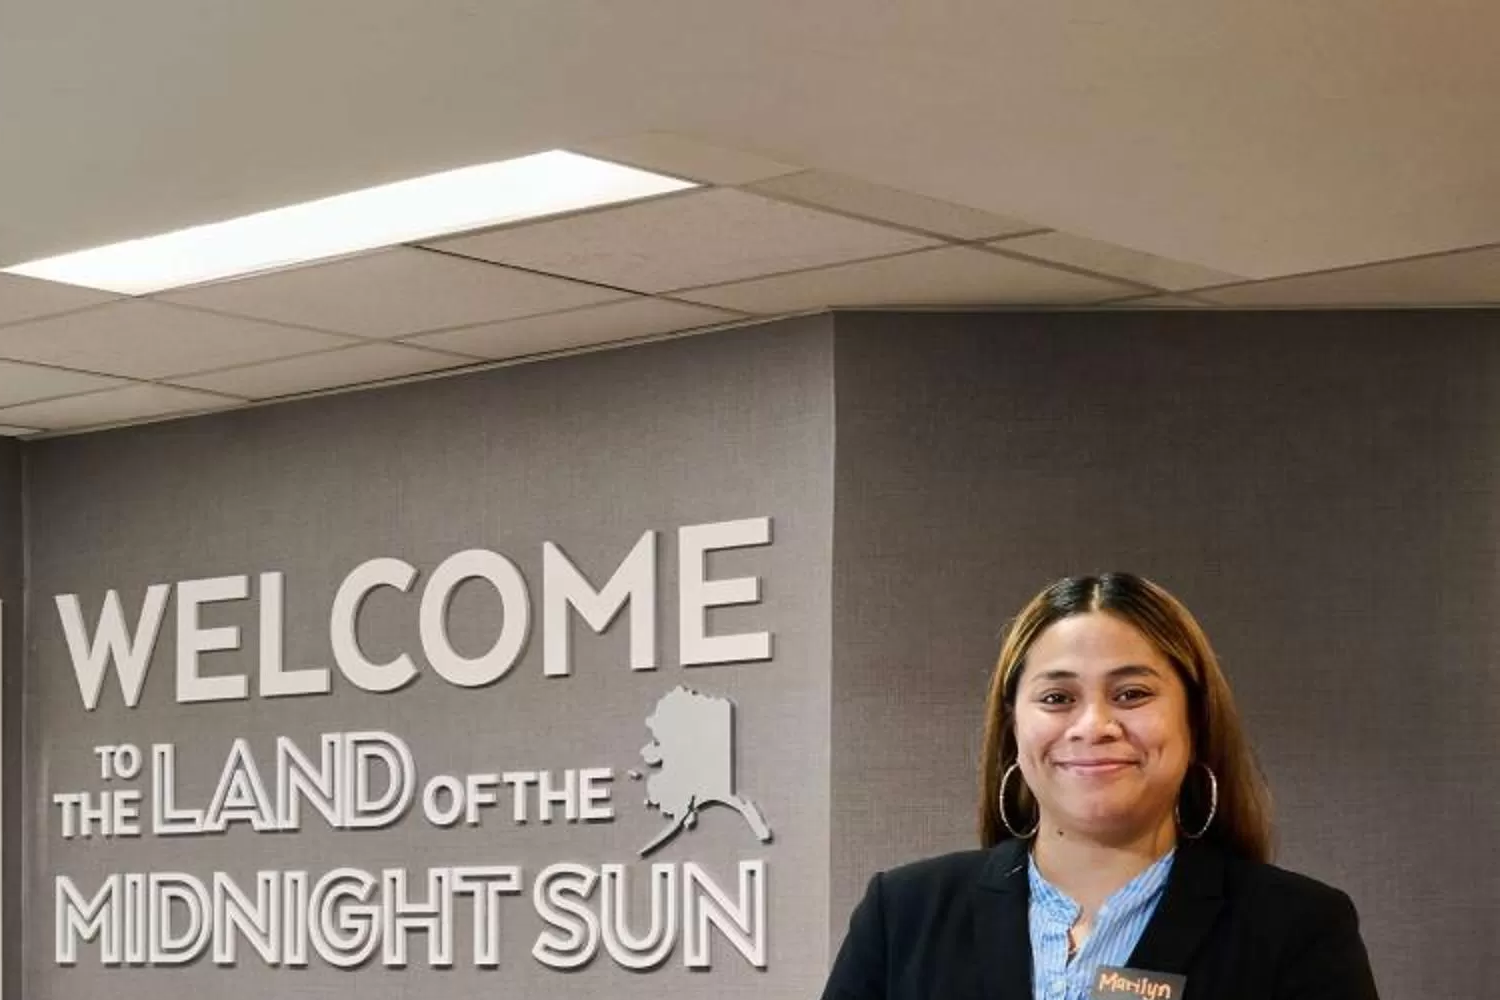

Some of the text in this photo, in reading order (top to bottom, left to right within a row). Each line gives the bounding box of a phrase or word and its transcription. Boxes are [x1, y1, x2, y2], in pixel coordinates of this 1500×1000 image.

[54, 517, 773, 710] WELCOME
[54, 730, 615, 838] THE LAND OF THE
[95, 743, 142, 779] TO
[54, 859, 768, 971] MIDNIGHT SUN
